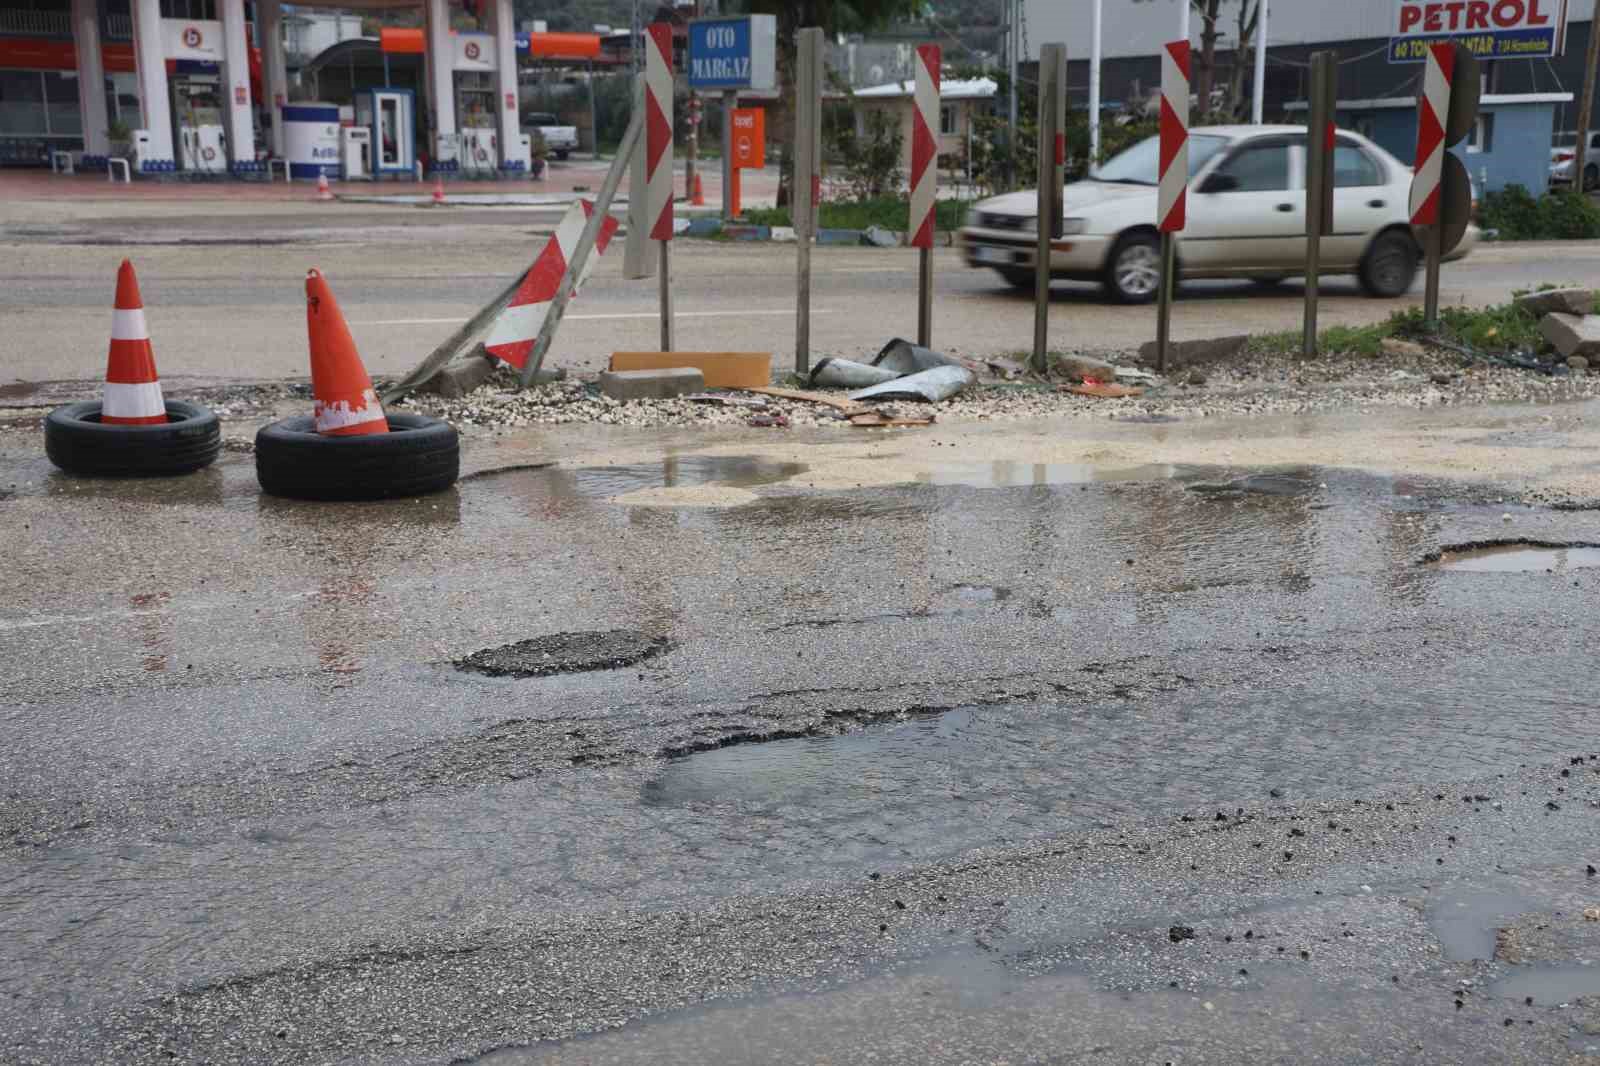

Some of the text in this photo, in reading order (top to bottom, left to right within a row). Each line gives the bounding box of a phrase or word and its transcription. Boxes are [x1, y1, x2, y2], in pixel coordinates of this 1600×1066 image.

[1399, 0, 1549, 32] PETROL
[706, 26, 735, 49] OTO
[692, 57, 749, 79] MARGAZ
